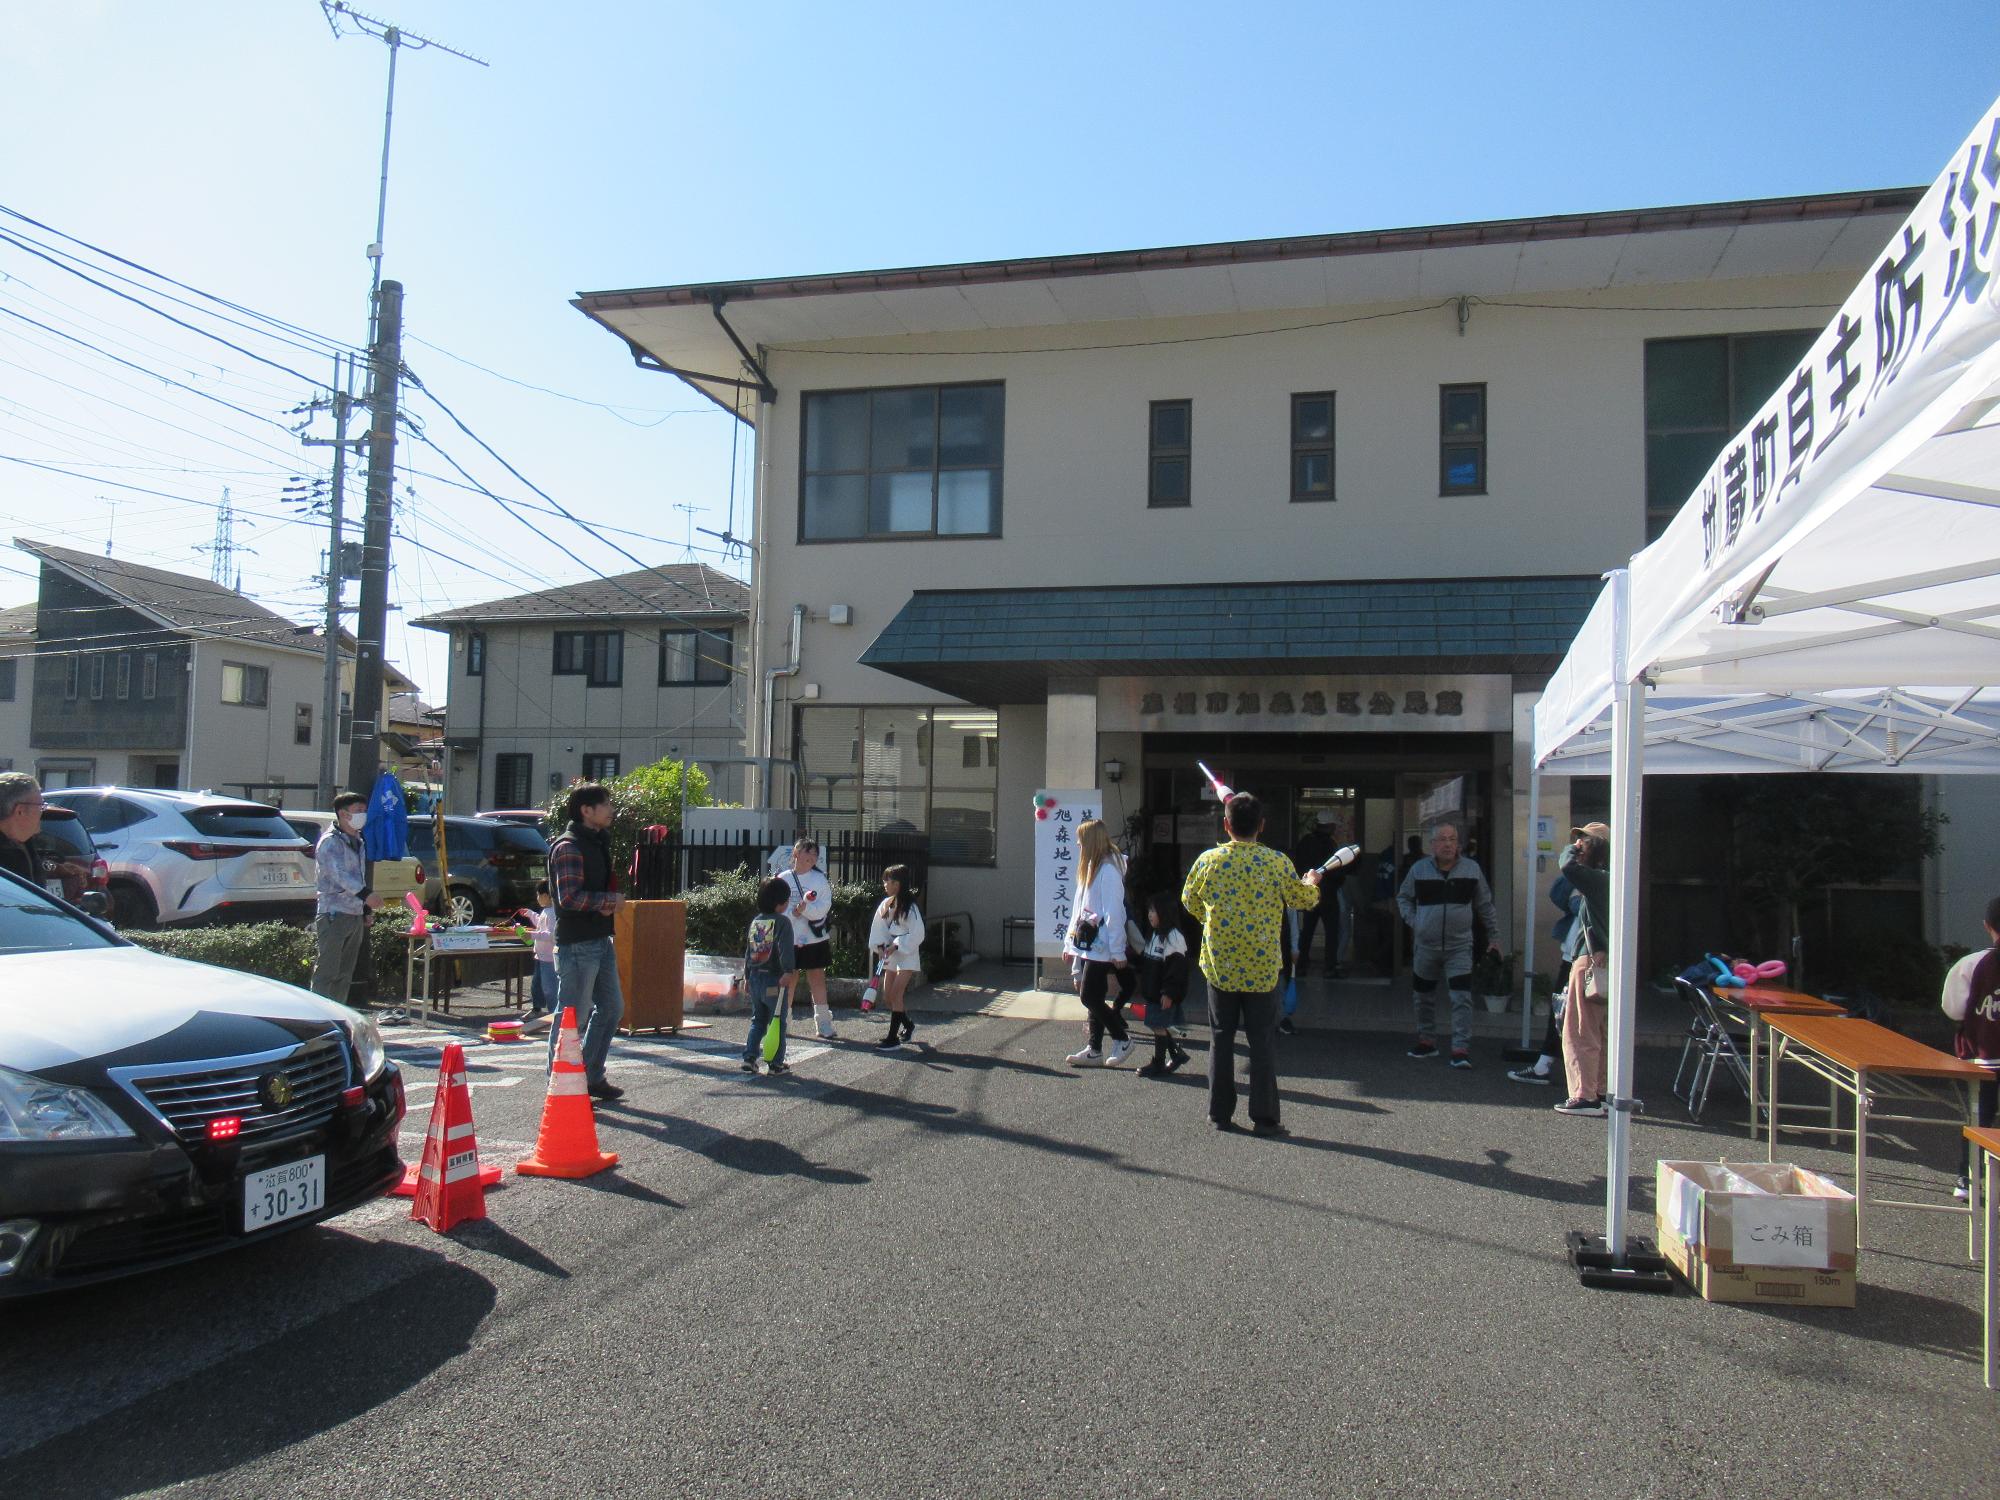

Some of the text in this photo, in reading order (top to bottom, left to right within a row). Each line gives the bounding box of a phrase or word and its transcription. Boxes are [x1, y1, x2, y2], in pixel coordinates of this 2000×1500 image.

[1053, 808, 1073, 941] 旭森地区文化祭
[264, 1178, 318, 1221] 30-31
[1750, 1224, 1813, 1247] ごみ箱
[1813, 1275, 1841, 1287] 150m
